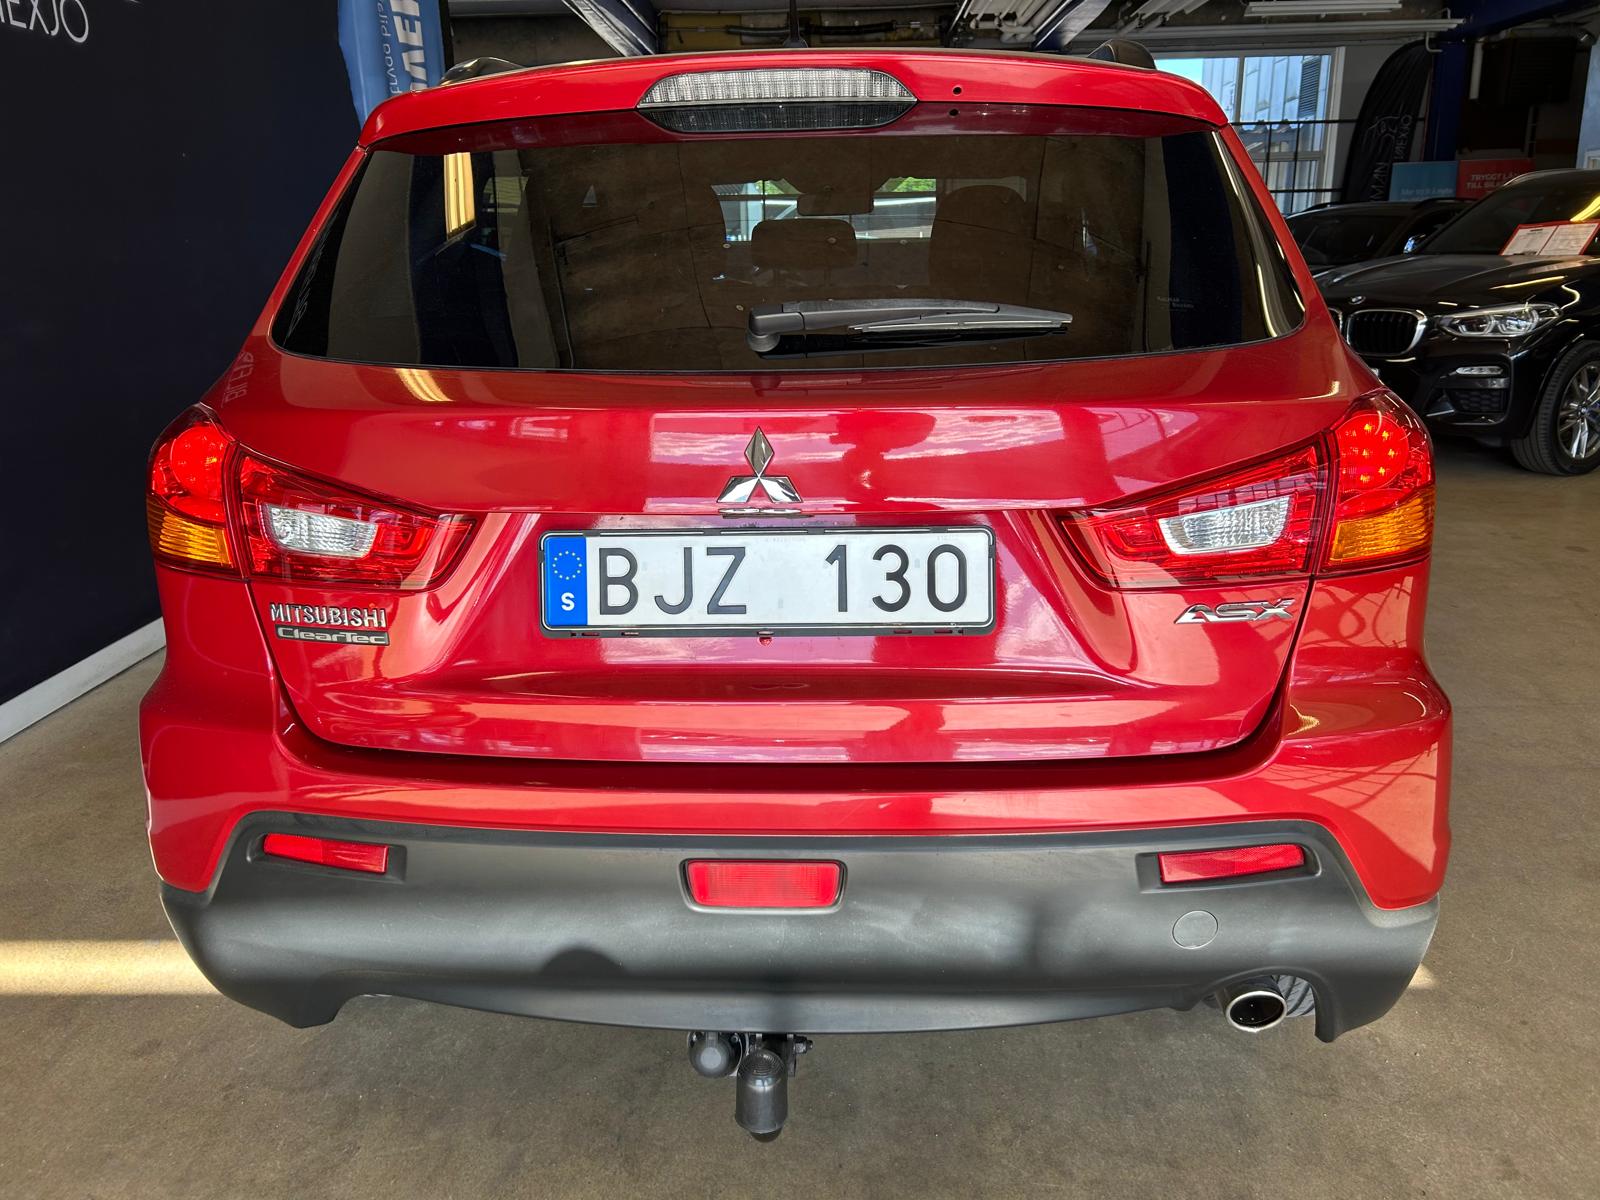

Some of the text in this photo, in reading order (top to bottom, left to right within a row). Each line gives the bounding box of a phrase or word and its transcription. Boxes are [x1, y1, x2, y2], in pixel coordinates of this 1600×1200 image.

[599, 544, 967, 615] BJZ 130
[561, 592, 575, 611] S
[1173, 598, 1296, 624] ASX
[270, 602, 387, 628] MITSUBISHI
[277, 626, 387, 645] ClearTec
